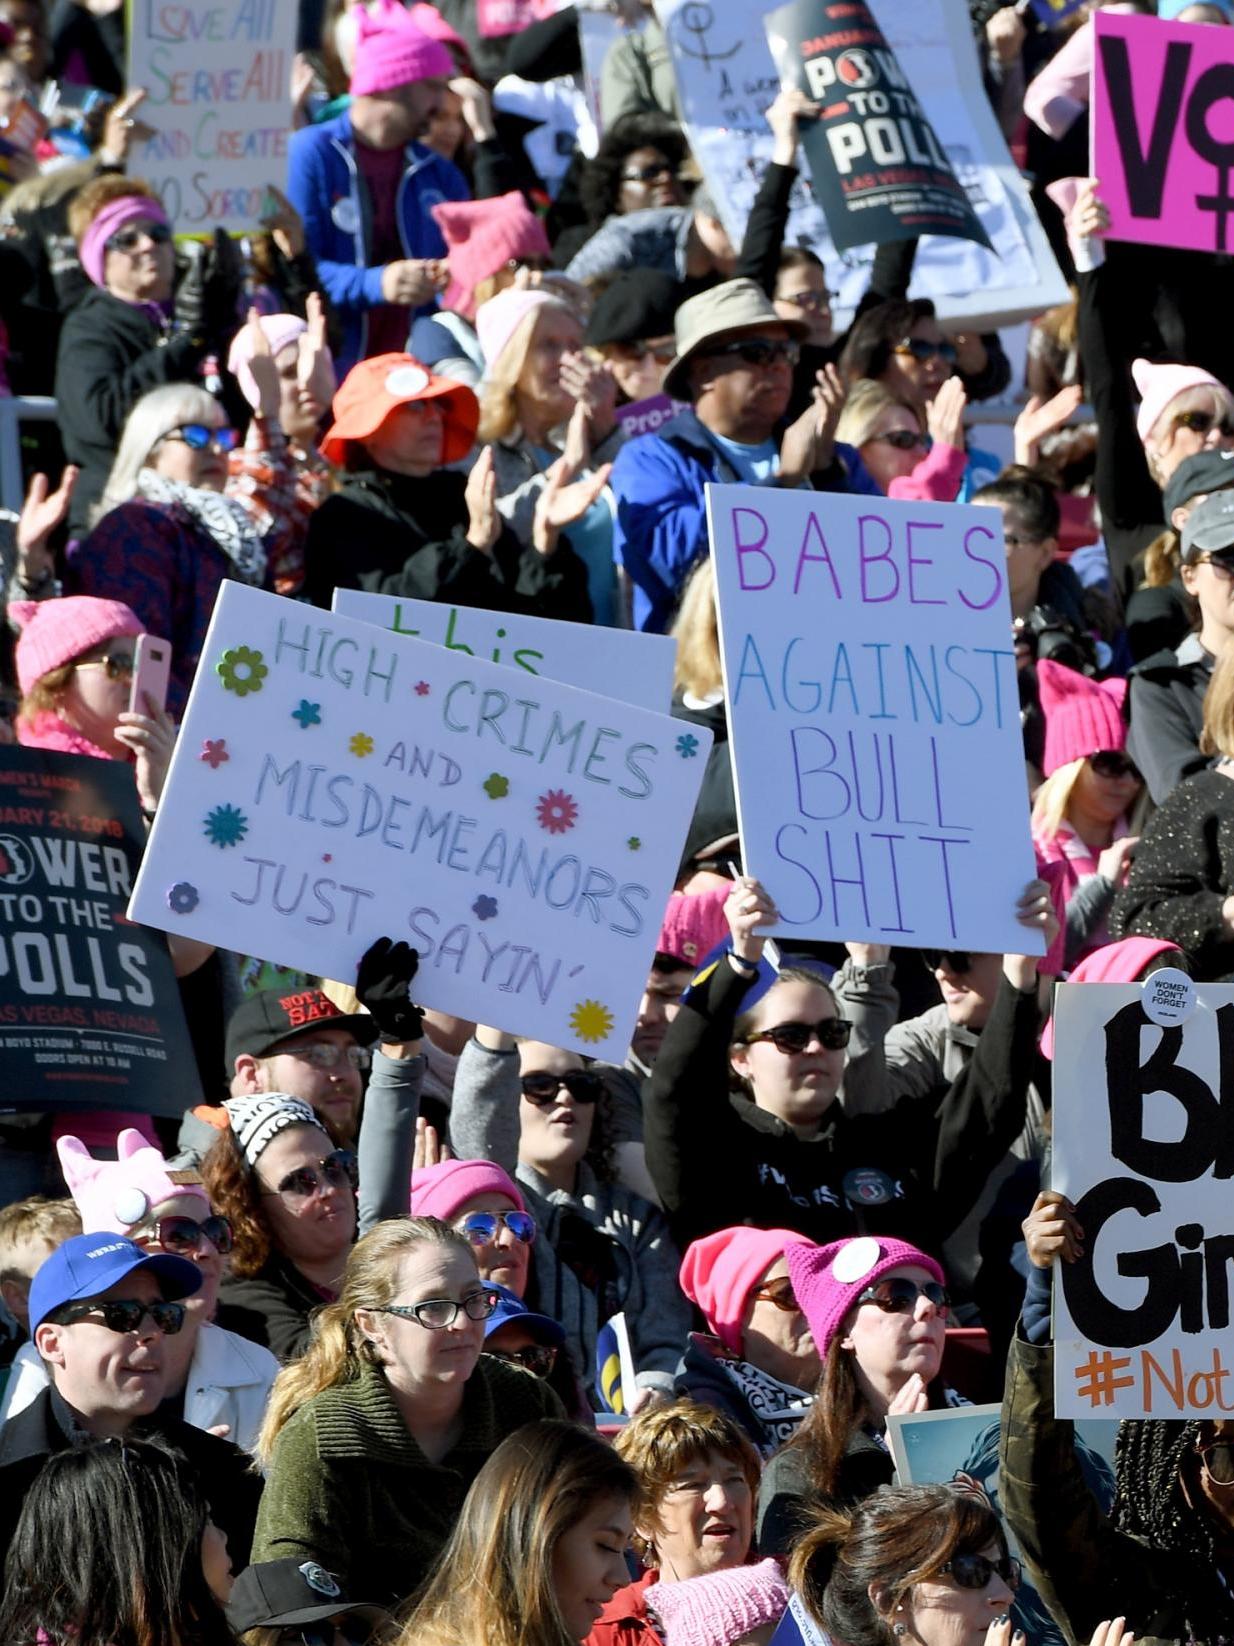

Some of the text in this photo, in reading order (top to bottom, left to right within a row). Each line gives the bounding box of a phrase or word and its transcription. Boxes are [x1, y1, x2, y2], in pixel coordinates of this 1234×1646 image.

[847, 90, 889, 115] TO
[731, 507, 1003, 610] BABES
[733, 633, 1016, 730] AGAINST
[275, 617, 658, 800] HIGH CRIMES
[383, 741, 462, 787] AND
[789, 726, 975, 830] BULL
[254, 752, 650, 938] MISDEMEANORS
[231, 856, 375, 935] JUST
[774, 823, 971, 939] SHIT
[0, 893, 114, 931] TO THE
[0, 931, 154, 1007] OLLS
[1154, 980, 1189, 993] WOMEN
[279, 993, 313, 1011] NOT
[1152, 997, 1188, 1009] FORGET
[1157, 988, 1184, 1000] DON'T
[32, 1037, 74, 1049] STADIUM
[94, 1011, 160, 1033] NEVADA
[68, 1054, 91, 1065] OPEN
